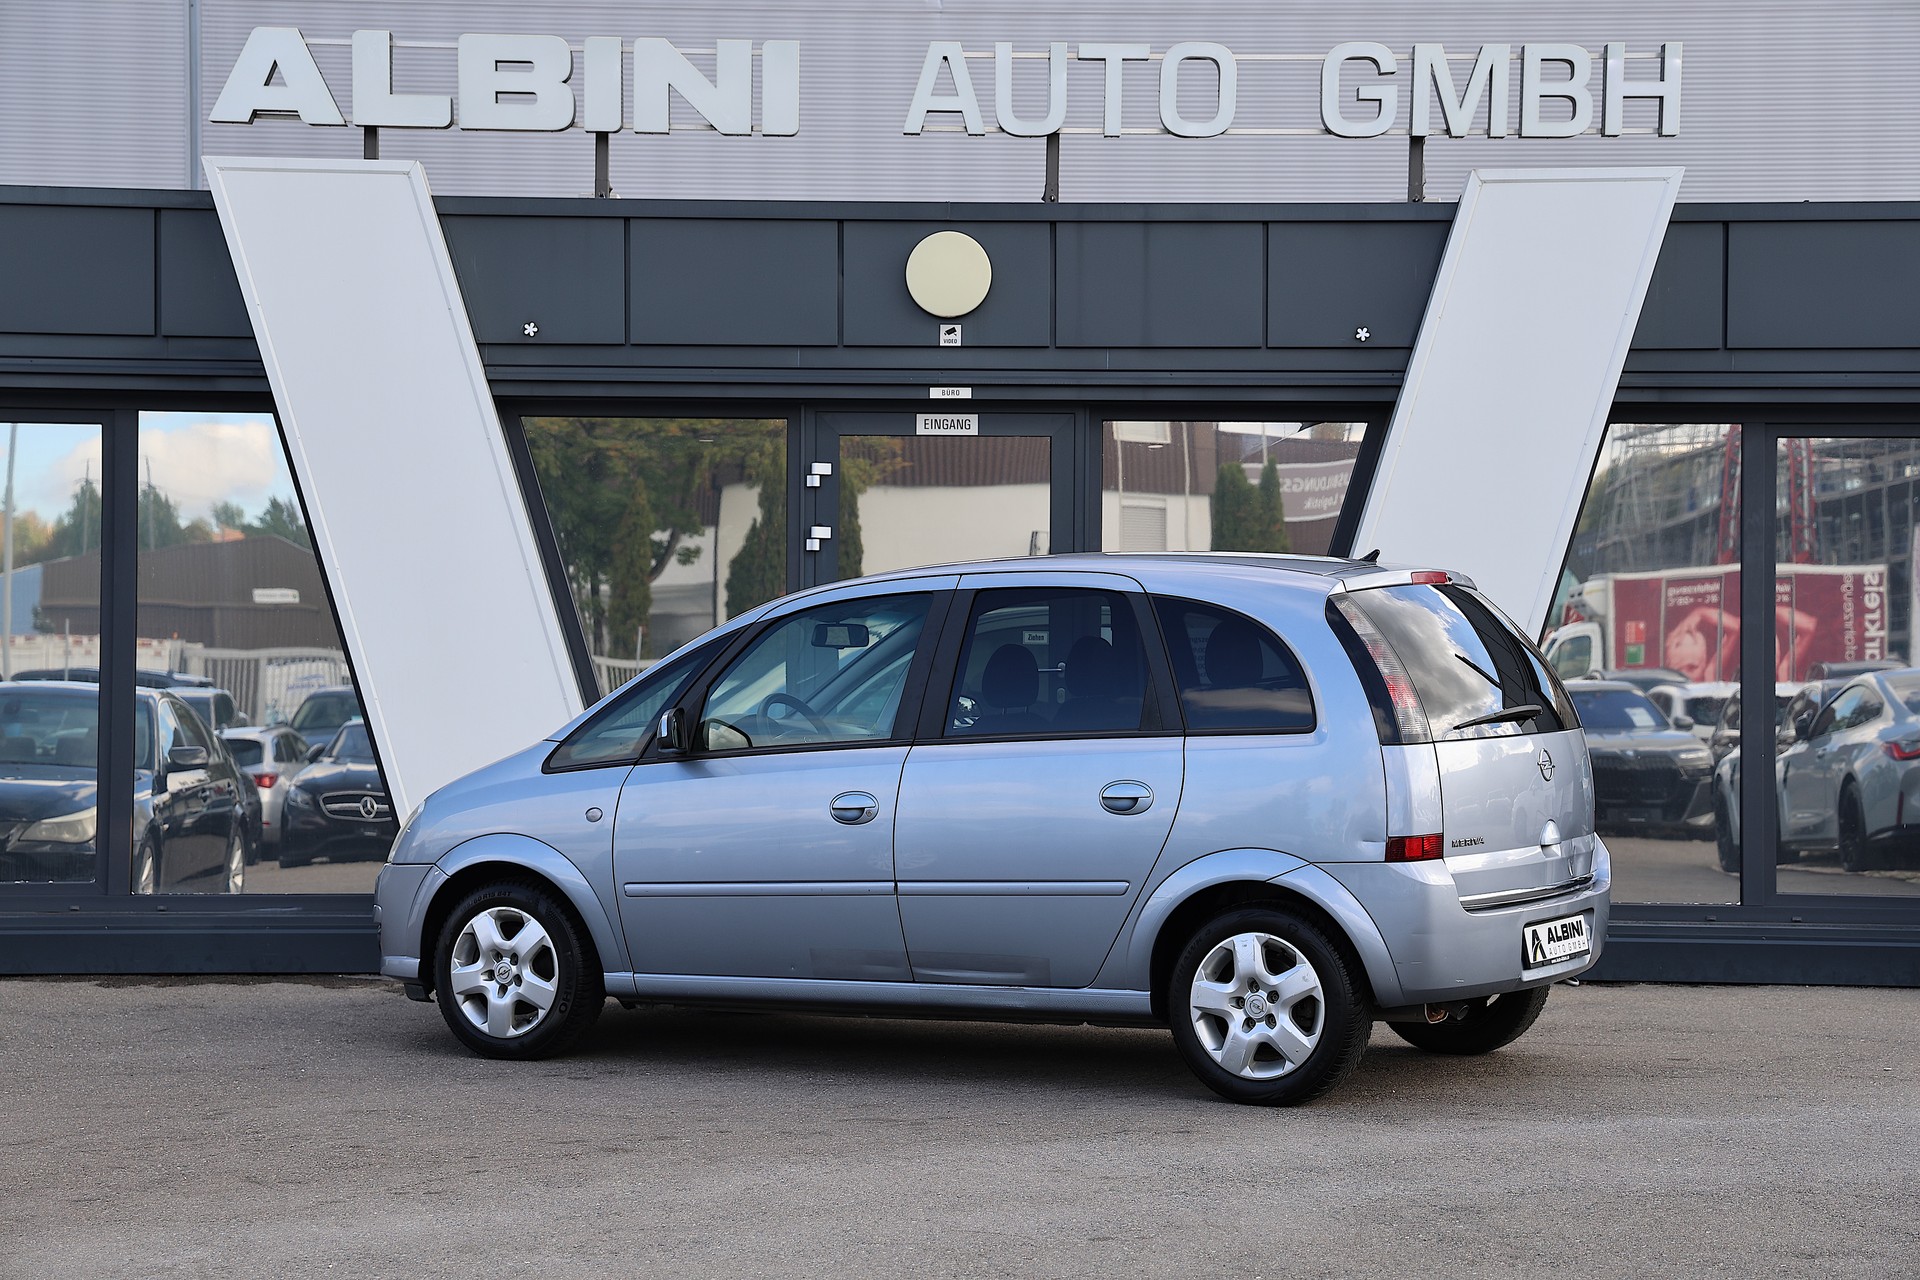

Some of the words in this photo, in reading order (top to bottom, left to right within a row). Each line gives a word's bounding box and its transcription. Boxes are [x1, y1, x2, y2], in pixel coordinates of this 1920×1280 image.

[209, 26, 801, 137] ALBINI
[903, 40, 1237, 138] AUTO
[1320, 40, 1684, 139] GMBH
[923, 418, 972, 430] EINGANG
[1451, 836, 1485, 848] MERIVA
[1547, 919, 1584, 945] ALBINI
[1549, 943, 1566, 957] AUTO
[1568, 940, 1587, 954] GMBH
